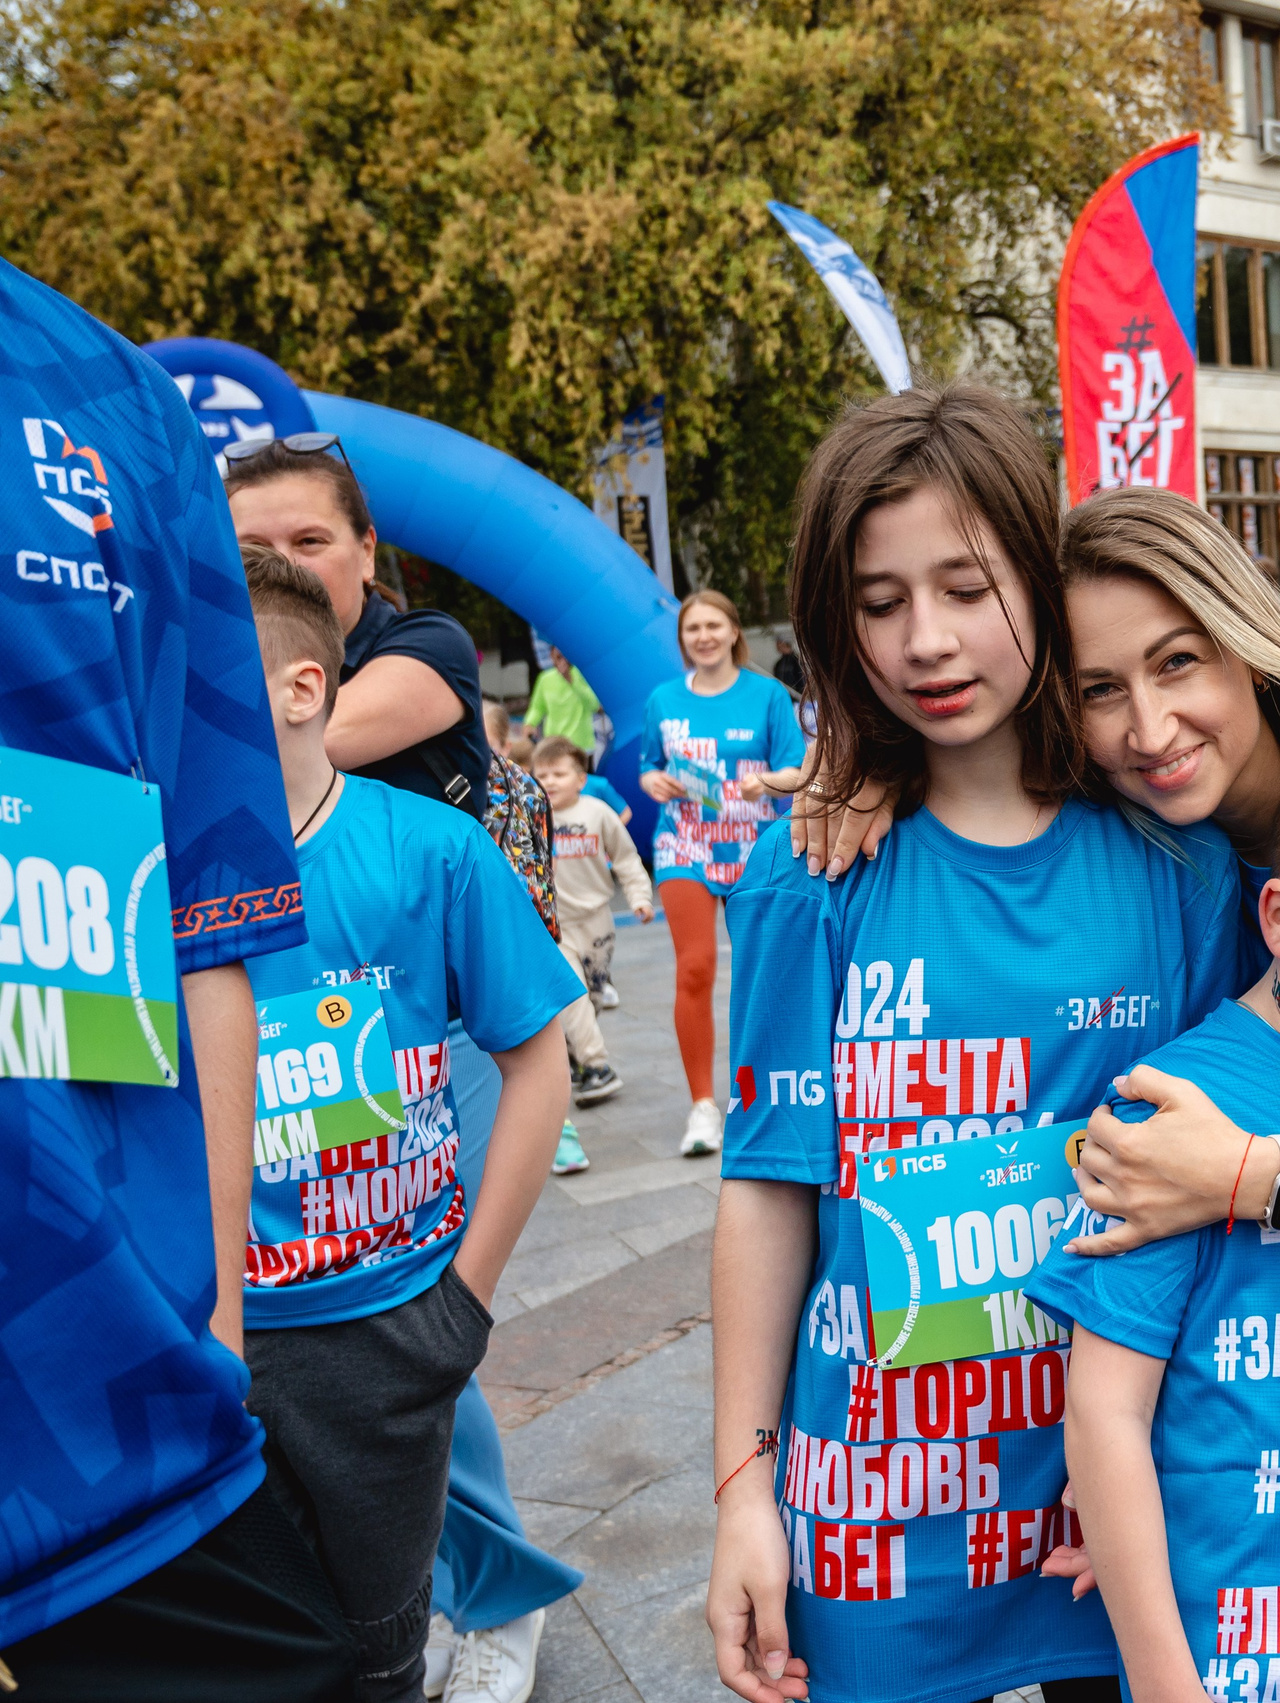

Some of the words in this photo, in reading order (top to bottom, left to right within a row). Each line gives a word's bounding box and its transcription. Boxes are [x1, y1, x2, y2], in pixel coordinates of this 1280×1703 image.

[1102, 350, 1173, 422] ЗА
[1097, 418, 1185, 488] БЕГ
[16, 549, 134, 613] СПОТ
[255, 1041, 343, 1110] 169
[832, 1038, 1031, 1118] #МЕЧТА
[903, 1153, 947, 1175] ПСБ
[927, 1193, 1080, 1290] 1006
[808, 1277, 877, 1362] #ЗА
[846, 1350, 1072, 1442] #ГОРДО
[968, 1498, 1085, 1589] #ЕД
